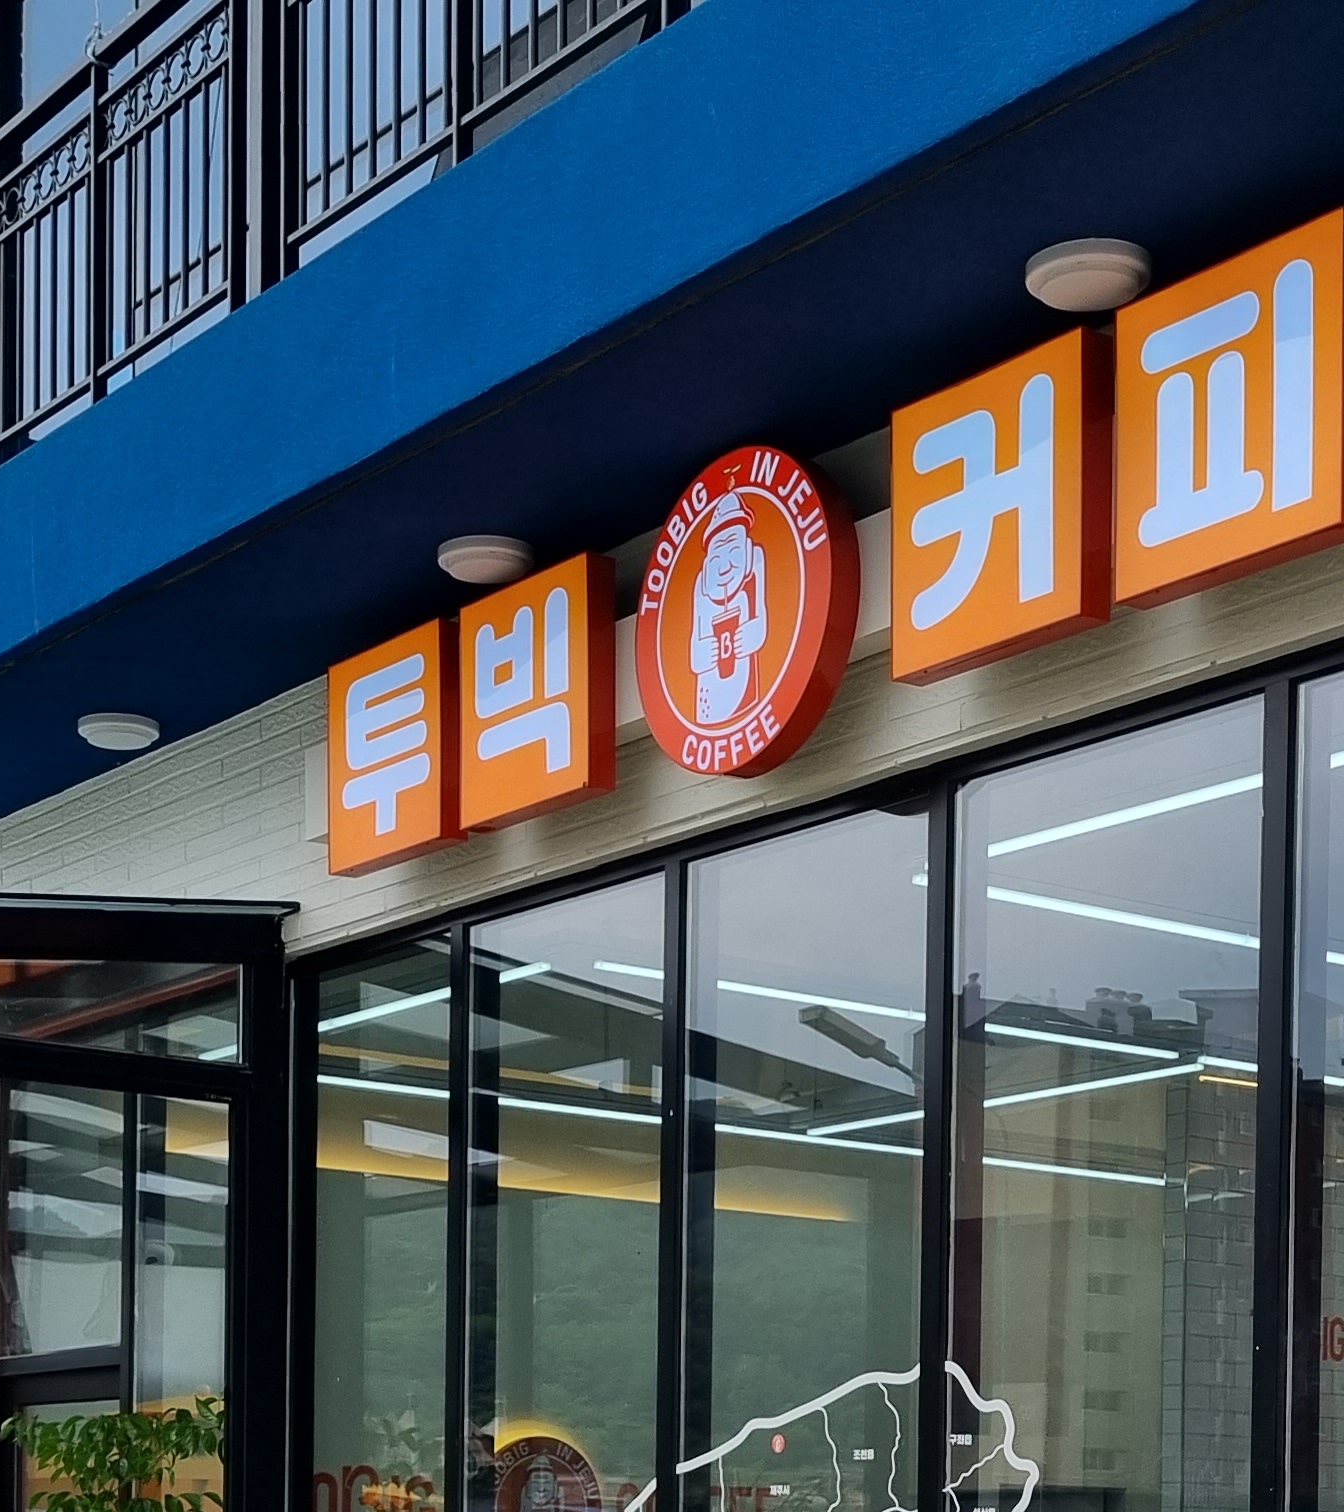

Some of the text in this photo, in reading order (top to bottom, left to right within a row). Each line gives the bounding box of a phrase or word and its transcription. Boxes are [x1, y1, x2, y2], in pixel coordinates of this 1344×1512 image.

[749, 451, 828, 552] IN JEJU
[342, 257, 1314, 836] 투빅 커피
[640, 481, 709, 617] TOOBIG
[681, 703, 782, 772] COFFEE
[494, 1442, 530, 1487] OBIG
[556, 1442, 600, 1500] IN JEJU
